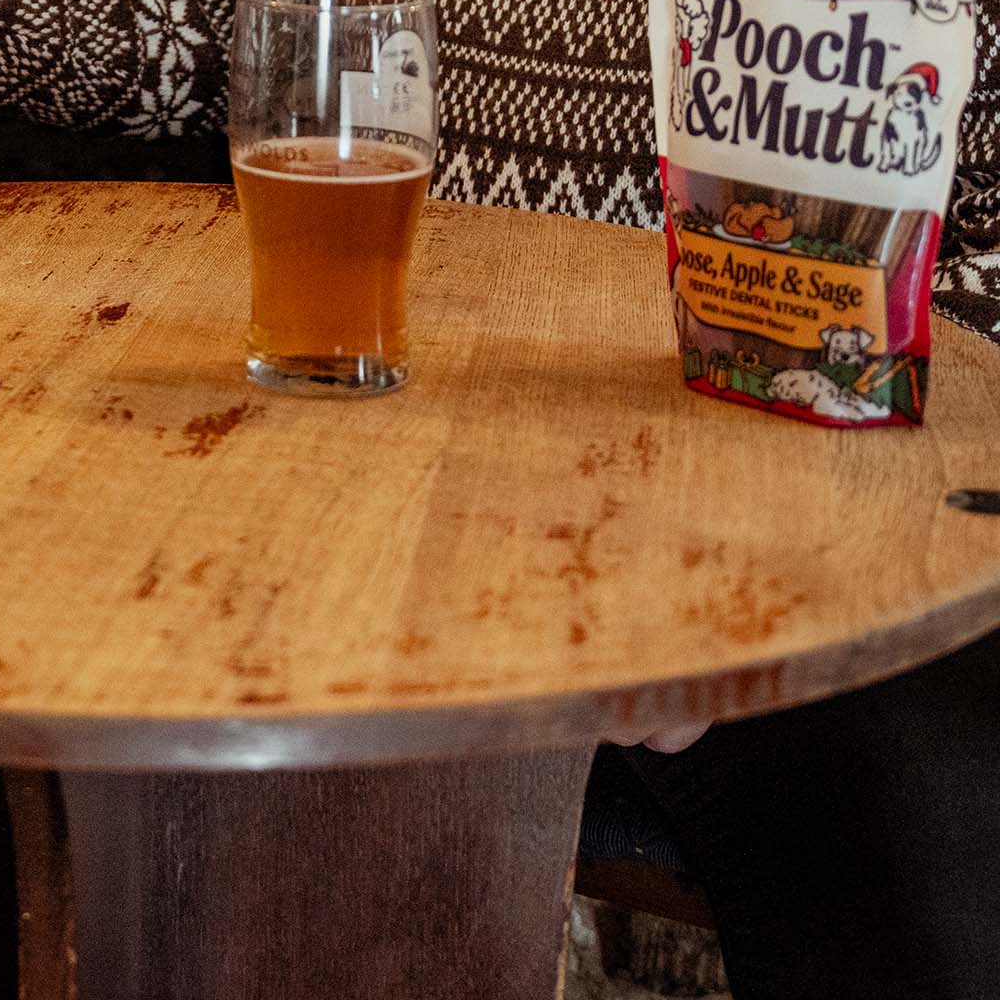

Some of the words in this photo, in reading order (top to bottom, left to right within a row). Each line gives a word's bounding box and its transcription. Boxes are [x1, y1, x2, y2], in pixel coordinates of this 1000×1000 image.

[719, 251, 776, 290] Apple
[781, 266, 802, 295] &
[805, 271, 862, 311] Sage
[730, 288, 771, 311] DENTAL
[775, 301, 819, 321] STICKS
